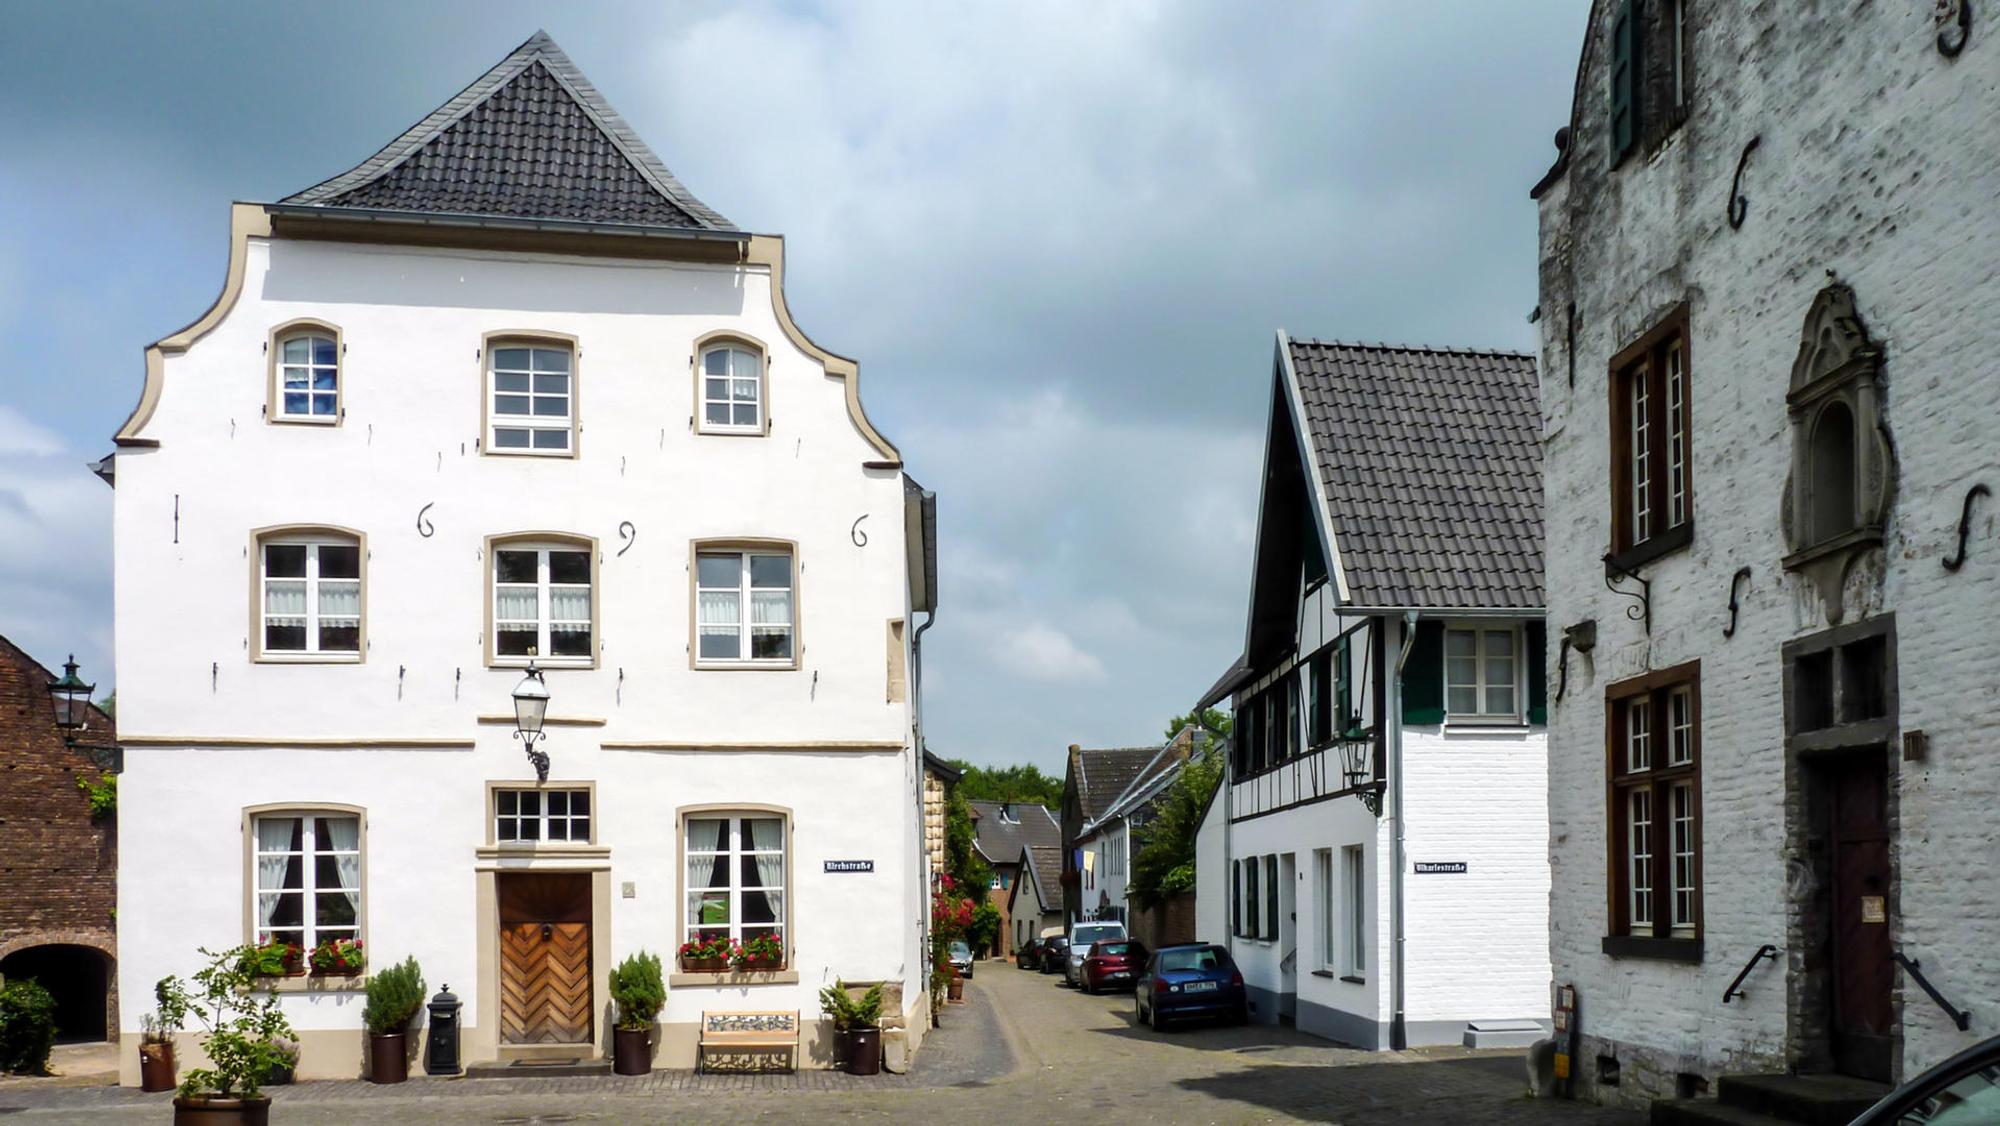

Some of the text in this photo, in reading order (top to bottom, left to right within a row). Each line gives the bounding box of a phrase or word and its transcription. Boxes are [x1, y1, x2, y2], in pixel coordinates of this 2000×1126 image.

[417, 501, 434, 538] 6
[617, 520, 636, 557] 9
[851, 513, 869, 547] 6
